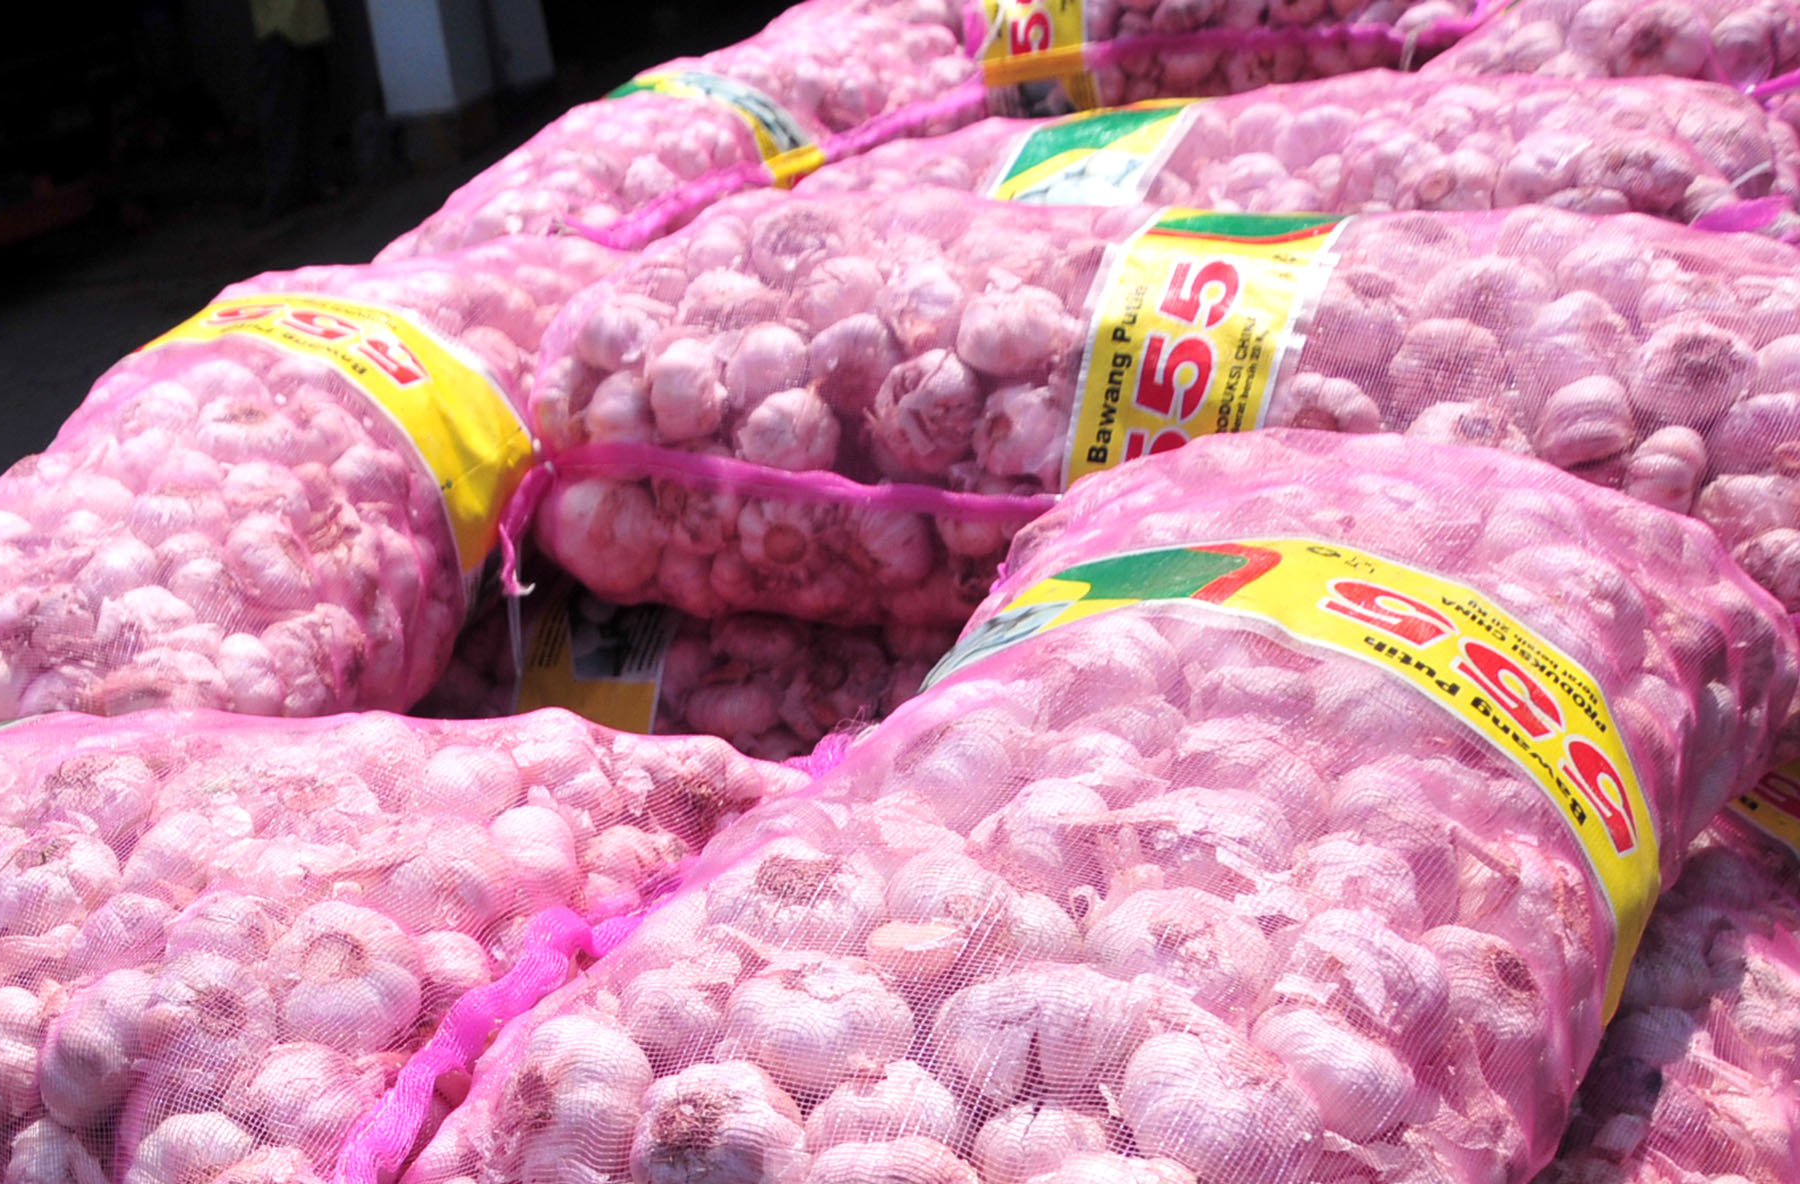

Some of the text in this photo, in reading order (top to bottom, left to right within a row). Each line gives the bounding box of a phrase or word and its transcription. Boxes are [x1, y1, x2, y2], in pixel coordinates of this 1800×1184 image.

[1087, 352, 1133, 464] Bawang
[1323, 582, 1637, 853] 555
[1364, 634, 1588, 827] Bawang Putih
[1439, 595, 1607, 733] PRODUKSI CHINA
